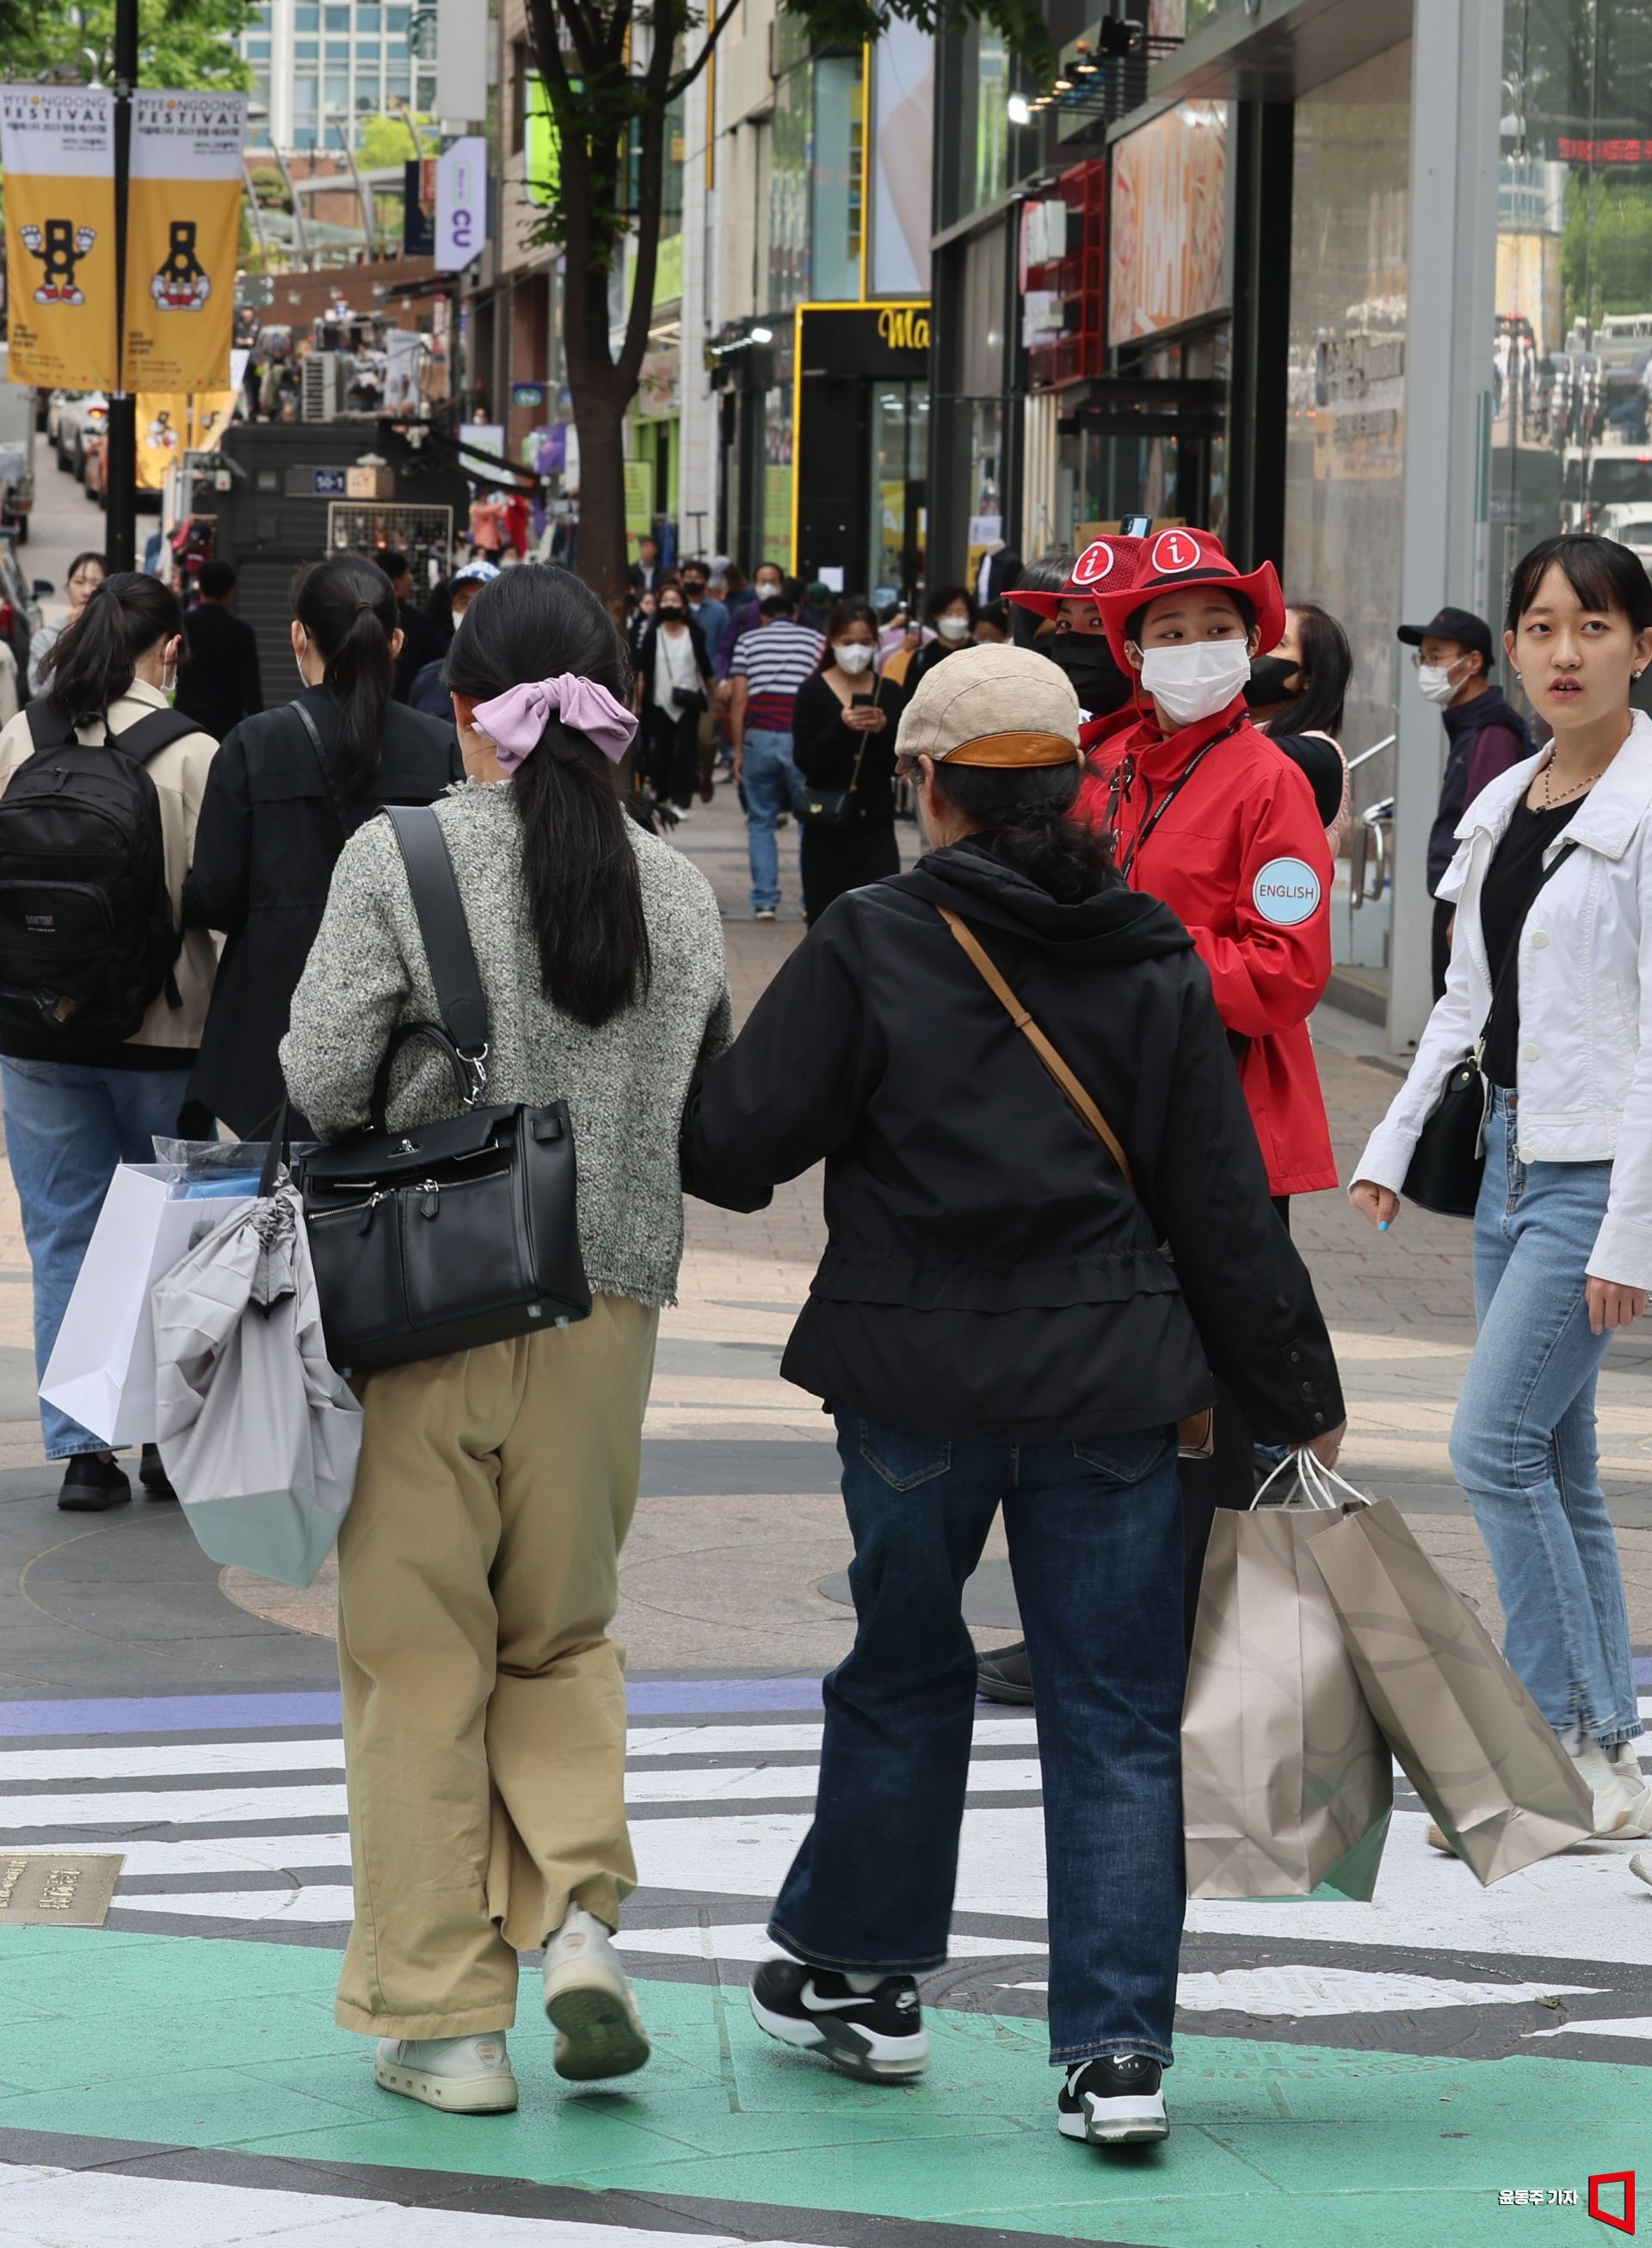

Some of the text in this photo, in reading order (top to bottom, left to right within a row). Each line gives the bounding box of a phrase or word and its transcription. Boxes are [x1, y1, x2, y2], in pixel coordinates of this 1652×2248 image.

[3, 95, 108, 108] MYEONGDONG
[138, 99, 242, 112] MYEONGDONG
[4, 107, 107, 121] FESTIVAL
[138, 111, 241, 125] FESTIVAL
[452, 209, 472, 249] CU
[1259, 884, 1315, 900] ENGLISH
[1118, 2061, 1140, 2071] AIR
